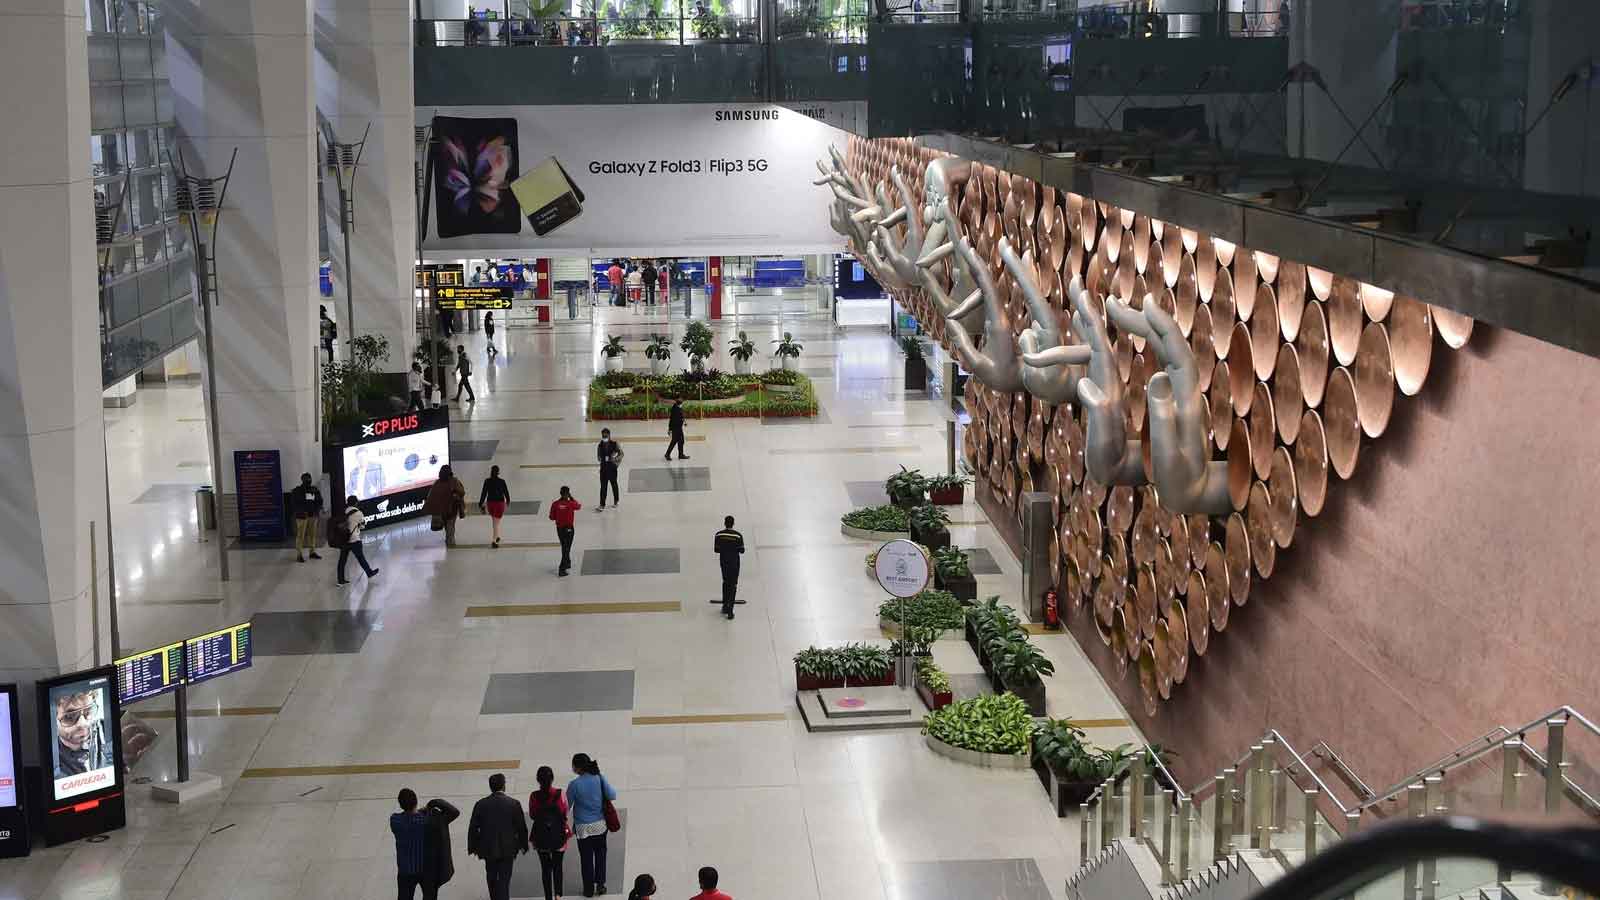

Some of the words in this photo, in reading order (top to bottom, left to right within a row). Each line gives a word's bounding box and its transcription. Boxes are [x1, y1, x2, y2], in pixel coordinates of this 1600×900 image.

[715, 110, 779, 121] SAMSUNG
[588, 161, 645, 176] Galaxy
[648, 161, 657, 173] Z
[661, 160, 701, 173] Fold3
[709, 159, 744, 176] Flip3
[747, 159, 768, 172] 5G
[375, 420, 389, 435] CP
[391, 415, 418, 432] PLUS
[62, 773, 107, 791] CARRERA
